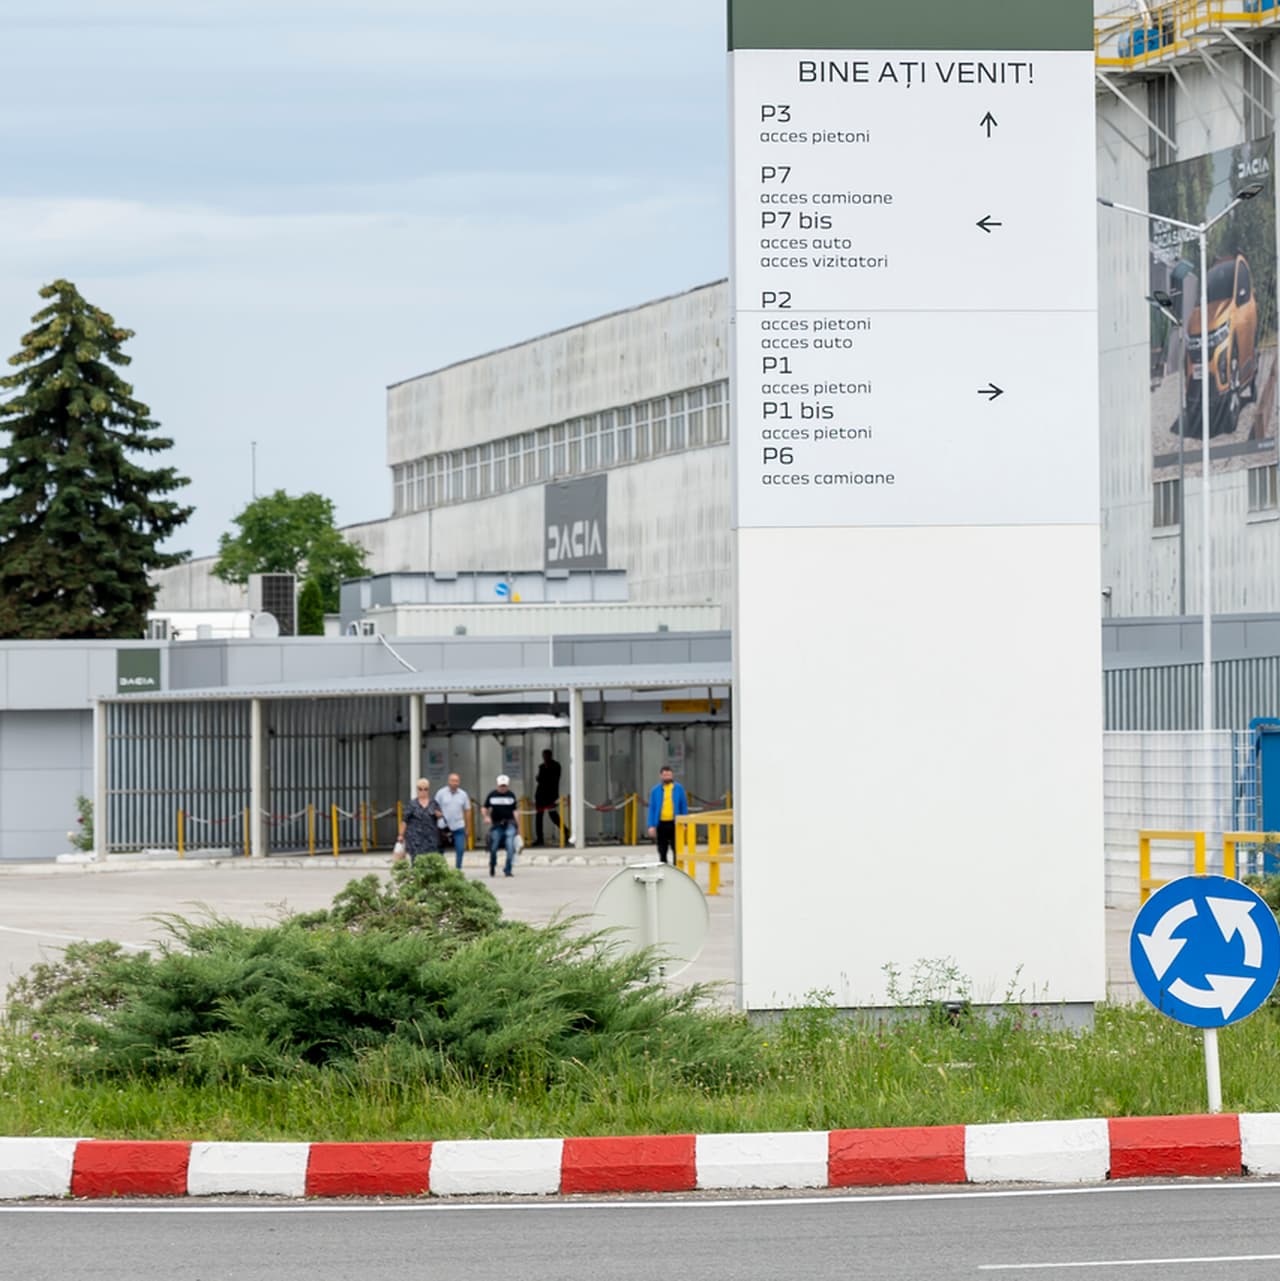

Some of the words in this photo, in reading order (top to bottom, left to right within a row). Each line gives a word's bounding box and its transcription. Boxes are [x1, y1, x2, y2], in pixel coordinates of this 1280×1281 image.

[799, 60, 870, 83] BINE
[935, 61, 1034, 84] VENIT!
[761, 104, 791, 123] P3
[759, 131, 808, 143] acces
[811, 129, 870, 145] pietoni
[761, 165, 792, 184] P7
[1238, 157, 1270, 179] DACIA
[759, 193, 808, 205] acces
[811, 191, 893, 205] camioane
[761, 211, 792, 230] P7
[799, 211, 833, 230] bis
[760, 238, 809, 250] acces
[812, 237, 852, 250] auto
[760, 256, 809, 268] acces
[812, 254, 888, 268] vizitatori
[761, 290, 792, 309] P2
[760, 319, 809, 331] acces
[813, 317, 871, 333] pietoni
[760, 338, 809, 350] acces
[812, 337, 853, 349] auto
[762, 356, 793, 375] P1
[761, 383, 810, 395] acces
[813, 380, 872, 397] pietoni
[762, 401, 793, 420] P1
[800, 401, 835, 420] bis
[761, 428, 810, 440] acces
[813, 425, 872, 442] pietoni
[763, 446, 794, 465] P6
[761, 474, 810, 486] acces
[813, 471, 895, 485] camioane
[547, 520, 603, 561] DACIA
[119, 677, 155, 686] DACIA
